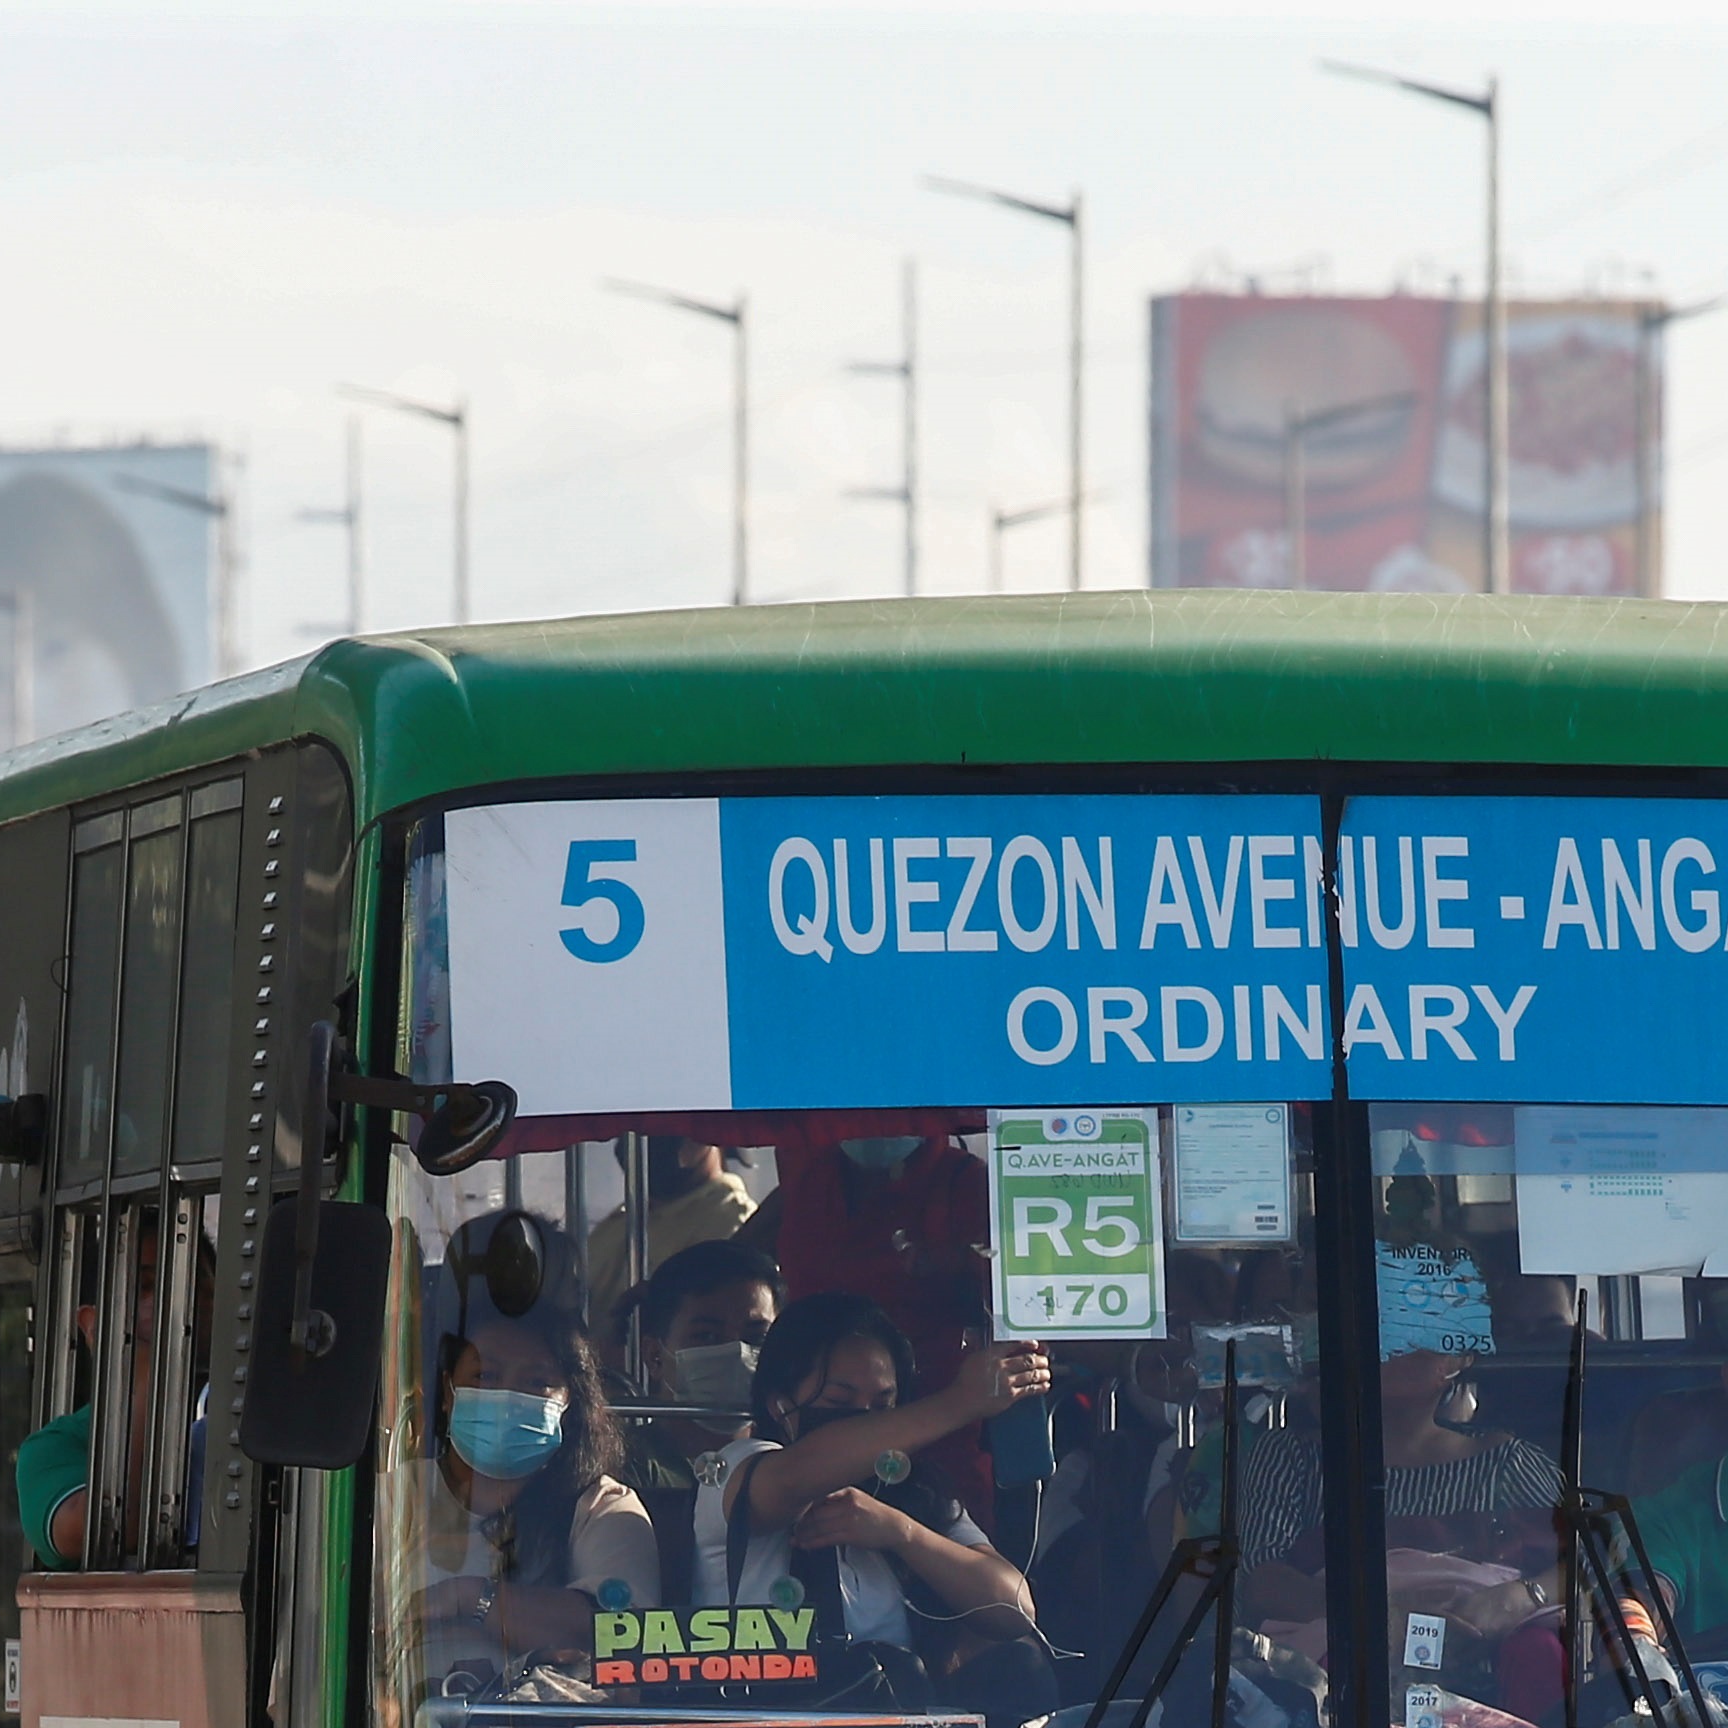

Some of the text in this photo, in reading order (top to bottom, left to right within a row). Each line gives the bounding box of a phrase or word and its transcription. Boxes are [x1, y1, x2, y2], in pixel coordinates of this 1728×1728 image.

[558, 838, 646, 963] 5
[768, 834, 1116, 963] QUEZON
[1140, 834, 1475, 952] AVENUE
[1006, 984, 1538, 1066] ORDINARY
[1008, 1152, 1139, 1168] Q.AVE-ANGAT
[1013, 1195, 1141, 1258] R5
[1392, 1246, 1473, 1260] INVENOR
[1417, 1262, 1452, 1276] 2016
[1037, 1284, 1129, 1317] 170
[1441, 1334, 1491, 1352] 0325
[594, 1608, 815, 1659] PASAY
[1411, 1625, 1439, 1638] 2019
[595, 1654, 817, 1685] ROTONDA
[1411, 1696, 1438, 1707] 2017
